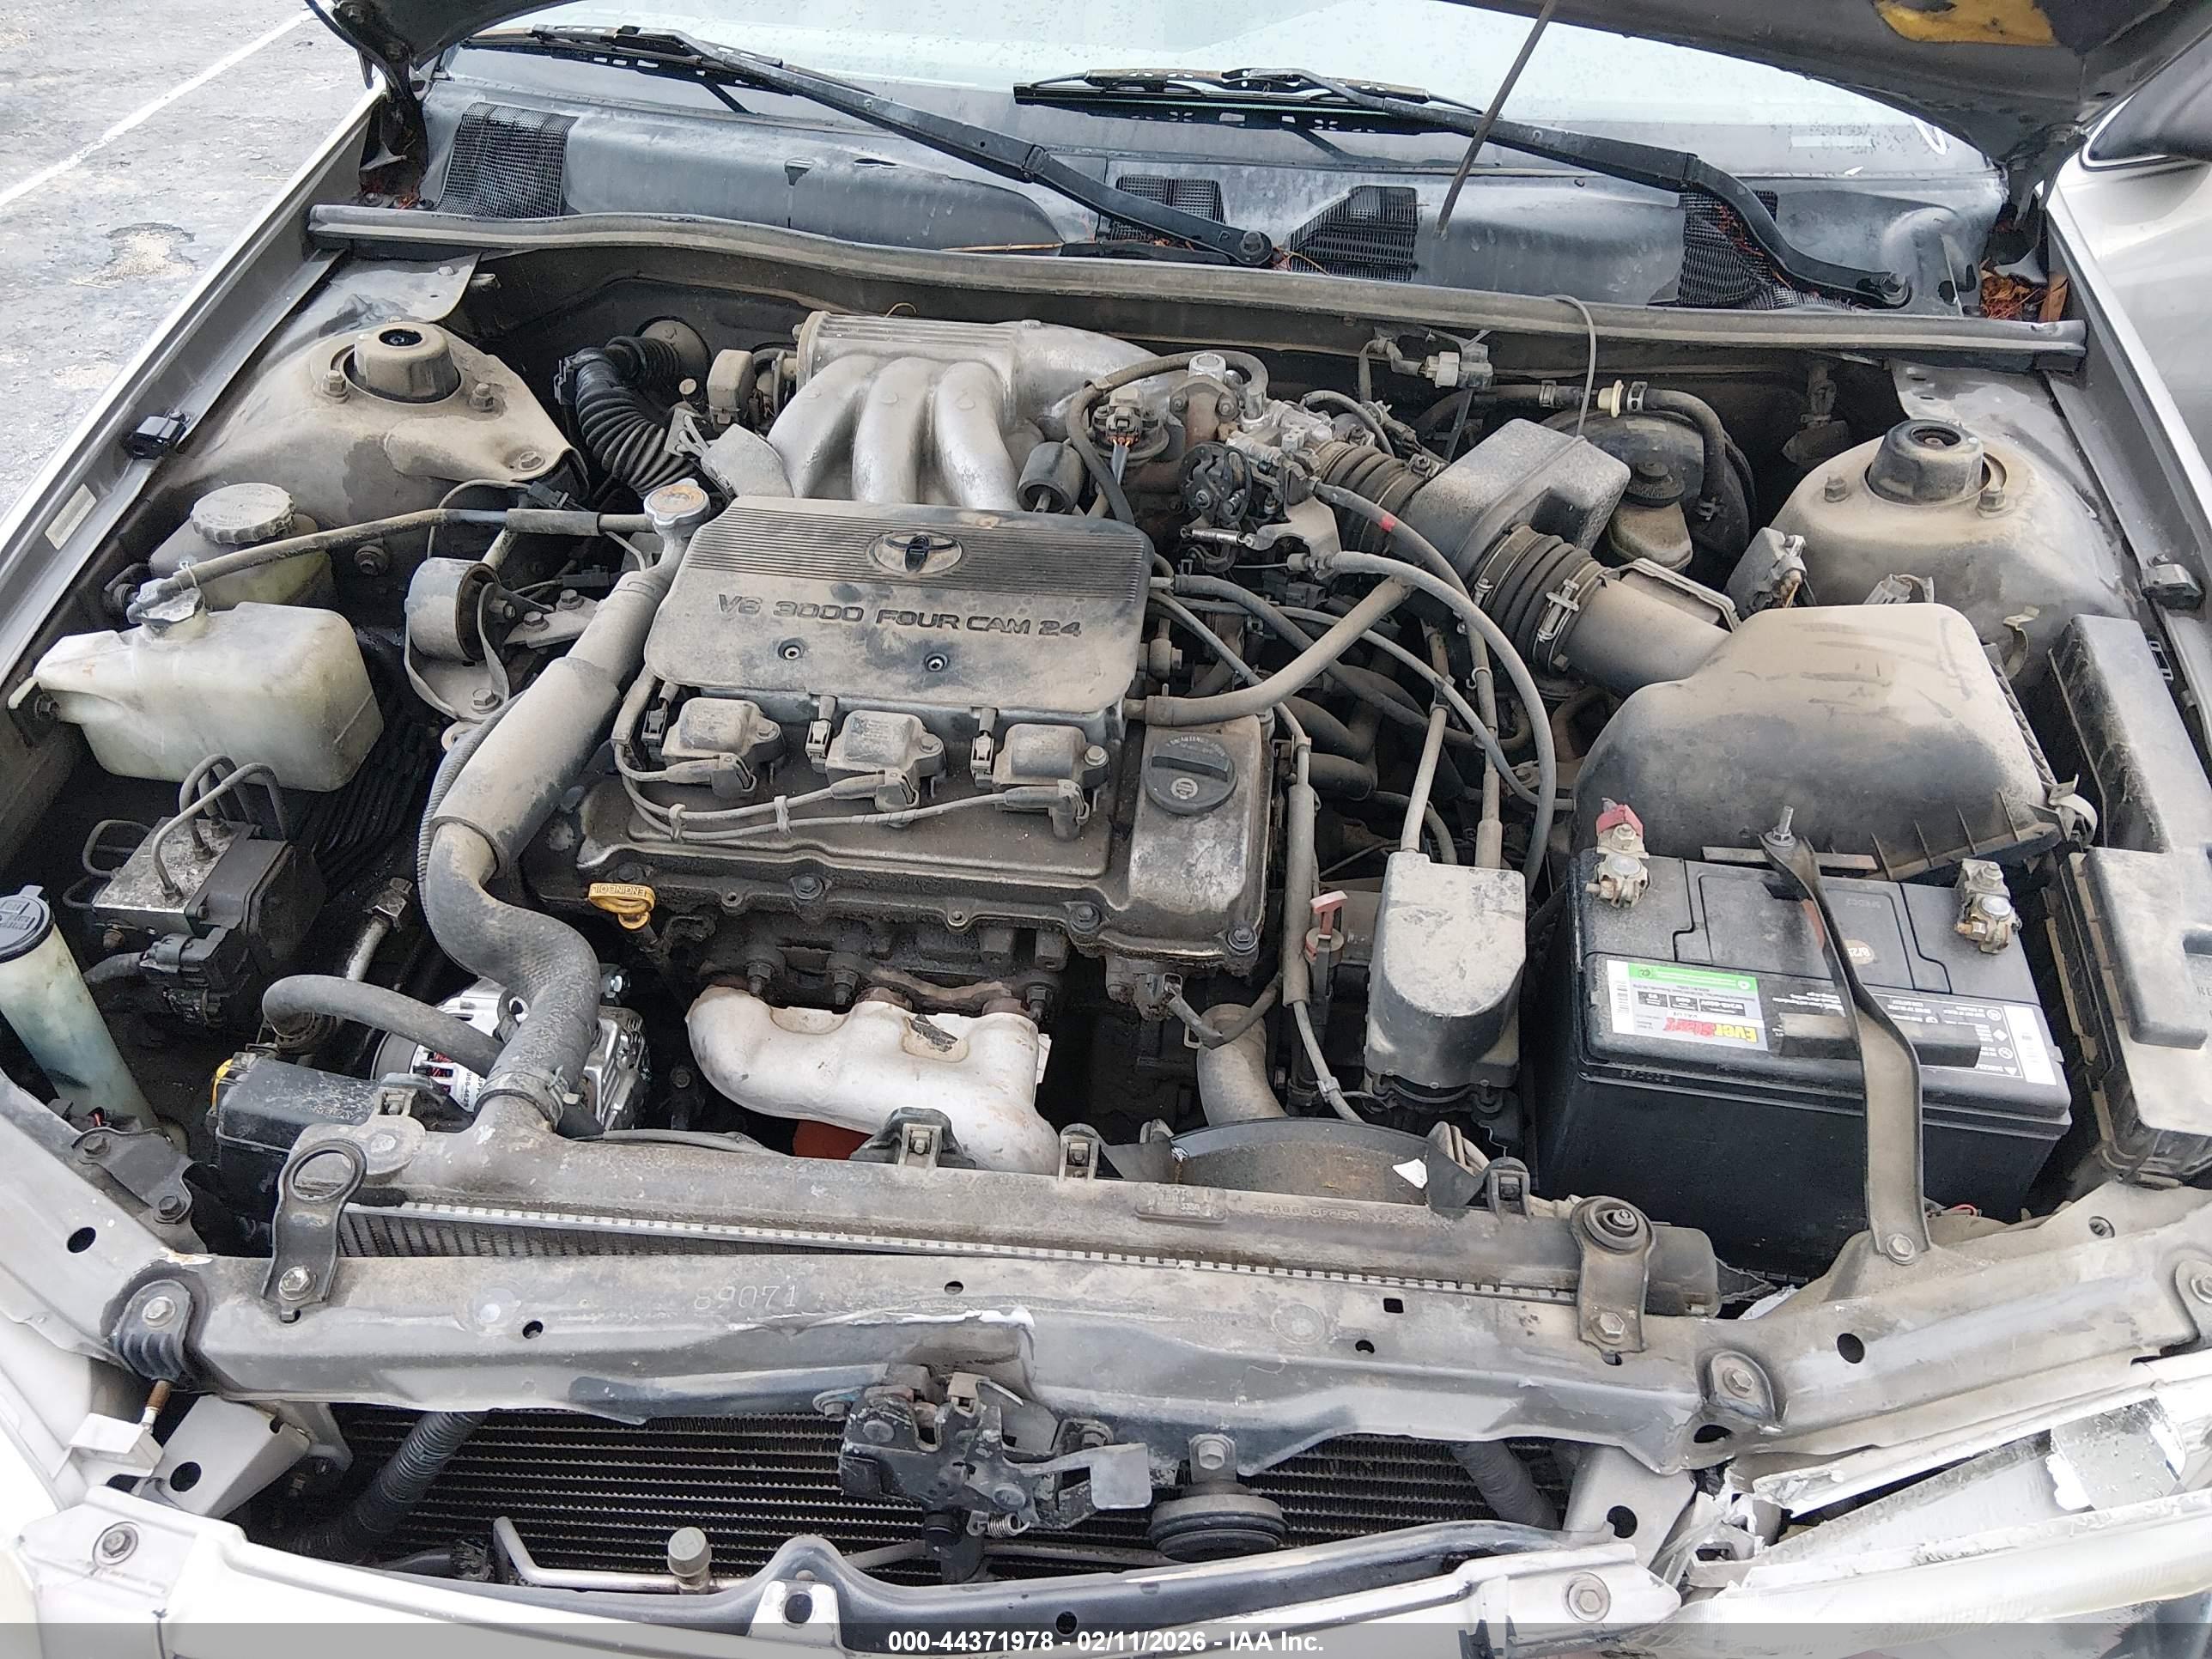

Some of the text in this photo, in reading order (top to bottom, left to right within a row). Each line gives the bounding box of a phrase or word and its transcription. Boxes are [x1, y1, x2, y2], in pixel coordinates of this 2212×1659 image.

[718, 593, 1082, 637] V6 3000 FOUR CAM 24
[592, 884, 649, 896] ENGINE OIL
[1662, 1017, 1759, 1044] EverStart
[693, 1285, 797, 1310] 89071
